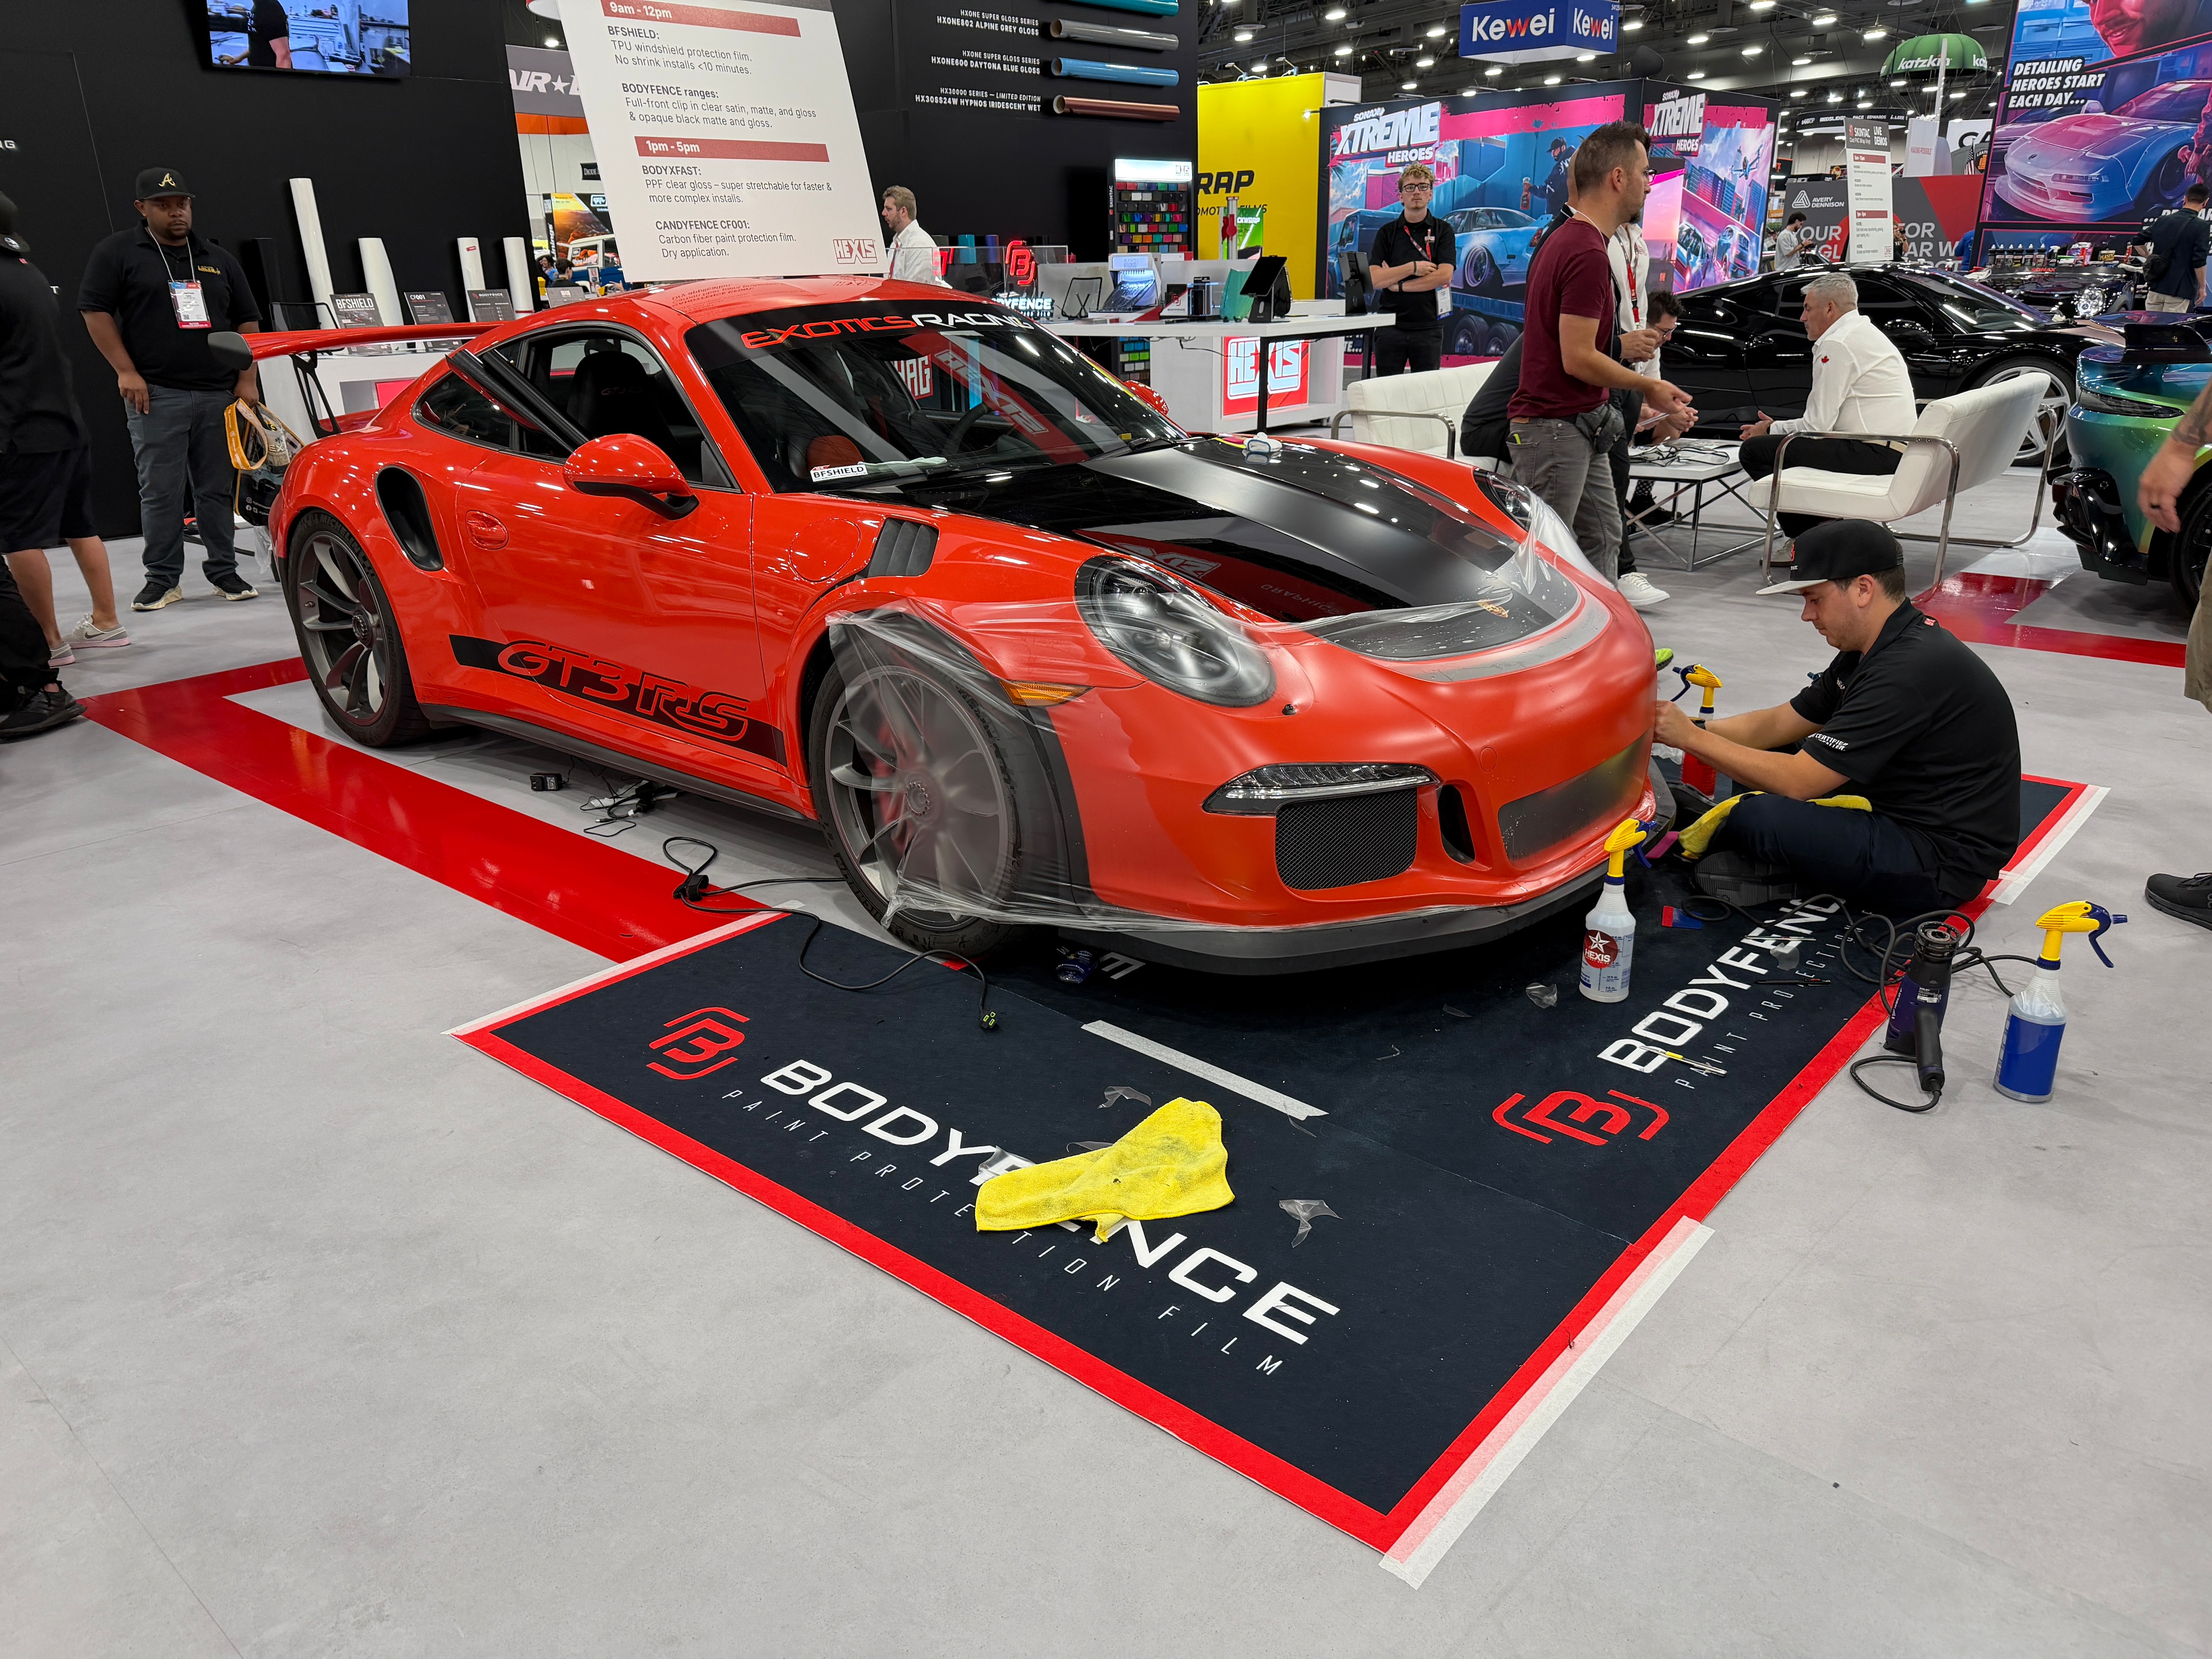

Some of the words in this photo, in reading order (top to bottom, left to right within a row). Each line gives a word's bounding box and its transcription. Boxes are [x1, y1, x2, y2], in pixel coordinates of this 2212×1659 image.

[609, 1, 636, 15] 9am
[642, 5, 672, 20] 12pm
[960, 9, 980, 18] HXONE
[982, 12, 999, 21] SUPER
[1001, 15, 1019, 23] GLOSS
[1020, 17, 1039, 26] SERIES
[607, 25, 660, 39] BFSHIELD:
[937, 15, 974, 27] HXONE802
[975, 21, 999, 31] ALPINE
[1000, 24, 1017, 33] GREY
[1018, 27, 1039, 36] GLOSS
[1472, 8, 1555, 42] Kewei
[1573, 8, 1613, 40] Kewei
[611, 40, 632, 51] TPU
[634, 42, 684, 55] windshield
[687, 48, 731, 60] protection
[733, 50, 752, 61] film.
[962, 50, 982, 58] HXONE
[983, 52, 1001, 61] SUPER
[1002, 54, 1020, 63] GLOSS
[614, 54, 629, 65] No
[632, 56, 661, 67] shrink
[662, 58, 695, 70] installs
[698, 61, 713, 71] <10
[715, 63, 752, 74] minutes.
[931, 56, 968, 67] HXONE600
[970, 60, 1002, 71] DAYTONA
[1003, 64, 1018, 72] BLUE
[1020, 65, 1040, 75] GLOSS
[2013, 59, 2082, 76] DETAILING
[2011, 77, 2062, 92] HEROES
[2063, 73, 2105, 88] START
[622, 83, 683, 96] BODYFENCE
[684, 89, 719, 100] ranges:
[940, 87, 967, 96] HX30000
[1019, 94, 1041, 102] EDITION
[625, 97, 670, 109] Full-front
[672, 100, 688, 112] clip
[690, 100, 699, 111] in
[701, 102, 722, 112] clear
[725, 104, 749, 115] satin,
[750, 106, 776, 117] matte,
[778, 107, 793, 116] and
[795, 108, 816, 119] gloss
[960, 98, 987, 108] HYPNOS
[988, 100, 1026, 111] IRIDESCENT
[1027, 104, 1041, 112] WET
[2008, 94, 2043, 108] EACH
[2044, 92, 2085, 106] DAY...
[629, 111, 636, 121] &
[639, 114, 673, 125] opaque
[676, 114, 701, 124] black
[703, 116, 727, 125] matte
[730, 117, 745, 126] and
[748, 118, 772, 129] gloss.
[1354, 107, 1384, 122] SONAX
[1649, 93, 1705, 136] XTREME
[1334, 101, 1441, 155] XTREME
[1855, 127, 1870, 138] SKINTAC
[1874, 126, 1882, 136] LIVE
[645, 140, 669, 154] 1pm
[676, 141, 700, 155] 5pm
[1676, 139, 1699, 151] HEROES
[1874, 136, 1887, 146] DEMOS
[1388, 147, 1433, 163] HEROES
[641, 165, 701, 176] BODYXFAST:
[645, 179, 662, 188] PPF
[666, 180, 687, 189] clear
[690, 180, 712, 191] gloss
[721, 182, 744, 192] super
[746, 181, 789, 190] stretchable
[791, 181, 801, 190] for
[803, 181, 824, 191] faster
[826, 182, 832, 191] &
[674, 193, 710, 205] complex
[711, 193, 743, 203] installs.
[656, 220, 719, 230] CANDYFENCE
[720, 220, 750, 229] CF001:
[659, 234, 691, 244] Carbon
[693, 234, 713, 243] fiber
[715, 233, 737, 245] paint
[737, 233, 778, 244] protection
[779, 232, 796, 242] film.
[661, 248, 677, 260] Dry
[680, 247, 729, 259] application.
[833, 239, 877, 264] HEXIS
[336, 298, 373, 309] BFSHIELD
[814, 466, 864, 479] BFSHIELD
[1585, 948, 1611, 963] HEXIS
[1597, 898, 1847, 1074] BODYFENC
[722, 1089, 830, 1142] PAINT
[849, 1151, 1120, 1292] PROTETION
[1158, 1305, 1283, 1376] FILM
